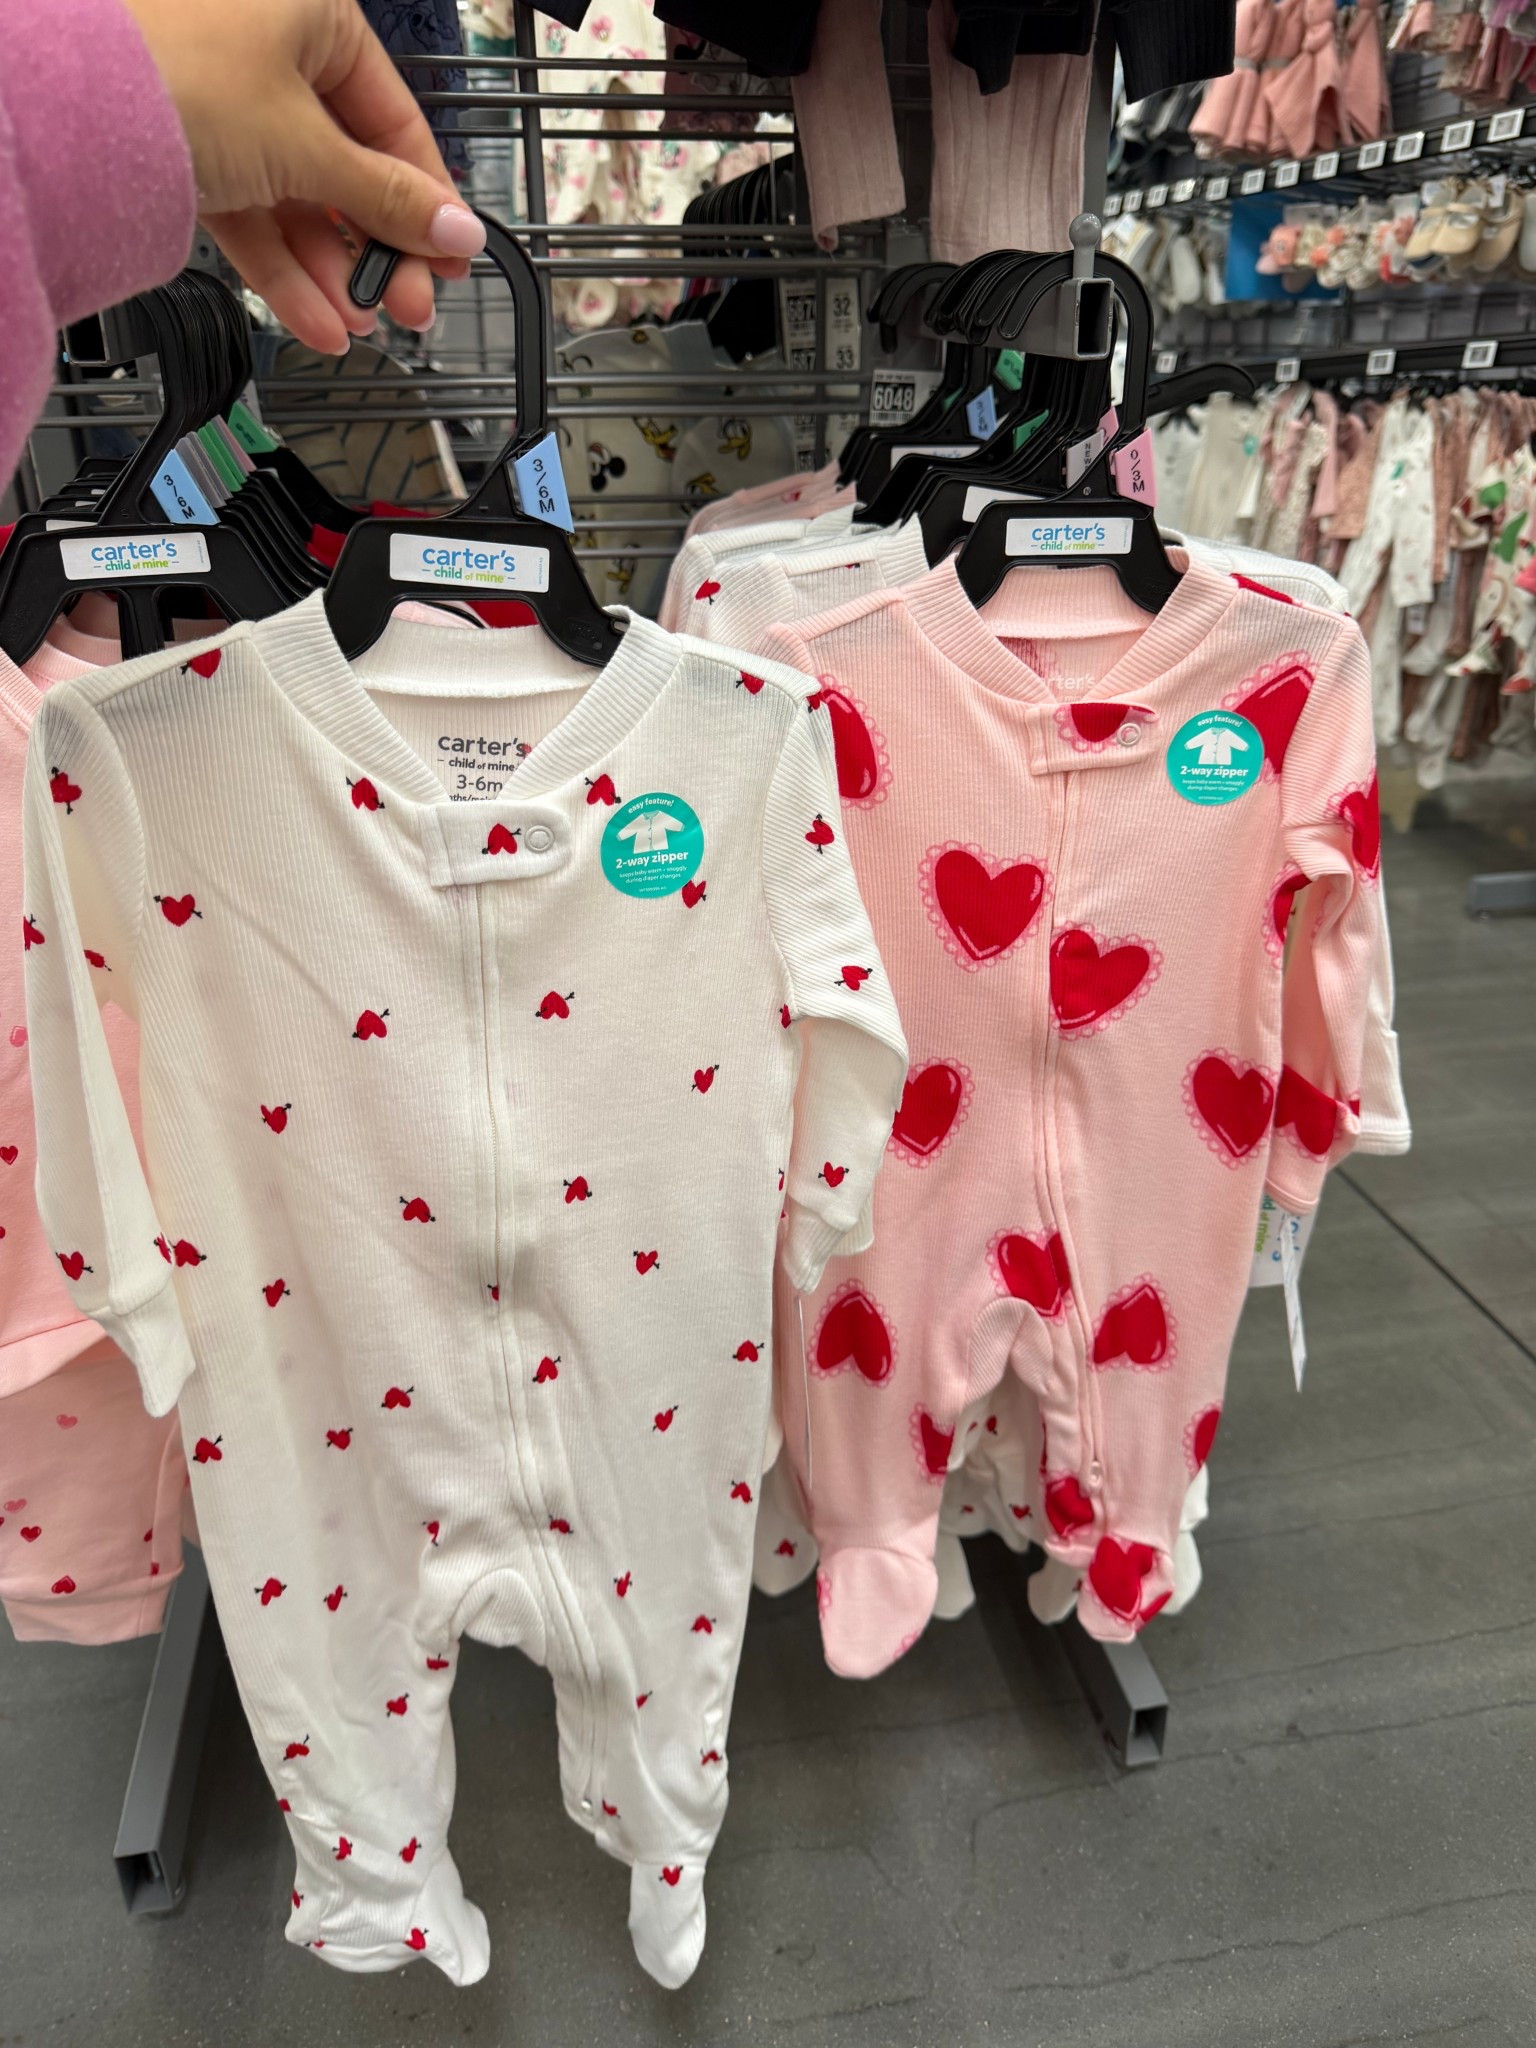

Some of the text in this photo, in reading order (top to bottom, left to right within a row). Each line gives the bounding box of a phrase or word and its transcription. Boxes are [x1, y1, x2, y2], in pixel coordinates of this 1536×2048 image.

[833, 297, 851, 318] 32
[873, 386, 914, 411] 6048
[1031, 523, 1105, 541] carter's
[91, 538, 177, 561] carter's
[1040, 541, 1063, 550] child
[1072, 542, 1096, 550] mine
[105, 558, 169, 571] child of mine
[422, 548, 515, 573] carter's
[434, 566, 505, 583] child of mine
[1048, 673, 1096, 690] rter's
[1197, 715, 1243, 727] easy feature!
[438, 736, 527, 757] carter's
[449, 757, 475, 769] child
[488, 761, 515, 771] mine
[1180, 766, 1248, 778] 2-way zipper
[628, 798, 675, 814] easy feature!
[616, 851, 689, 869] 2-way zipper
